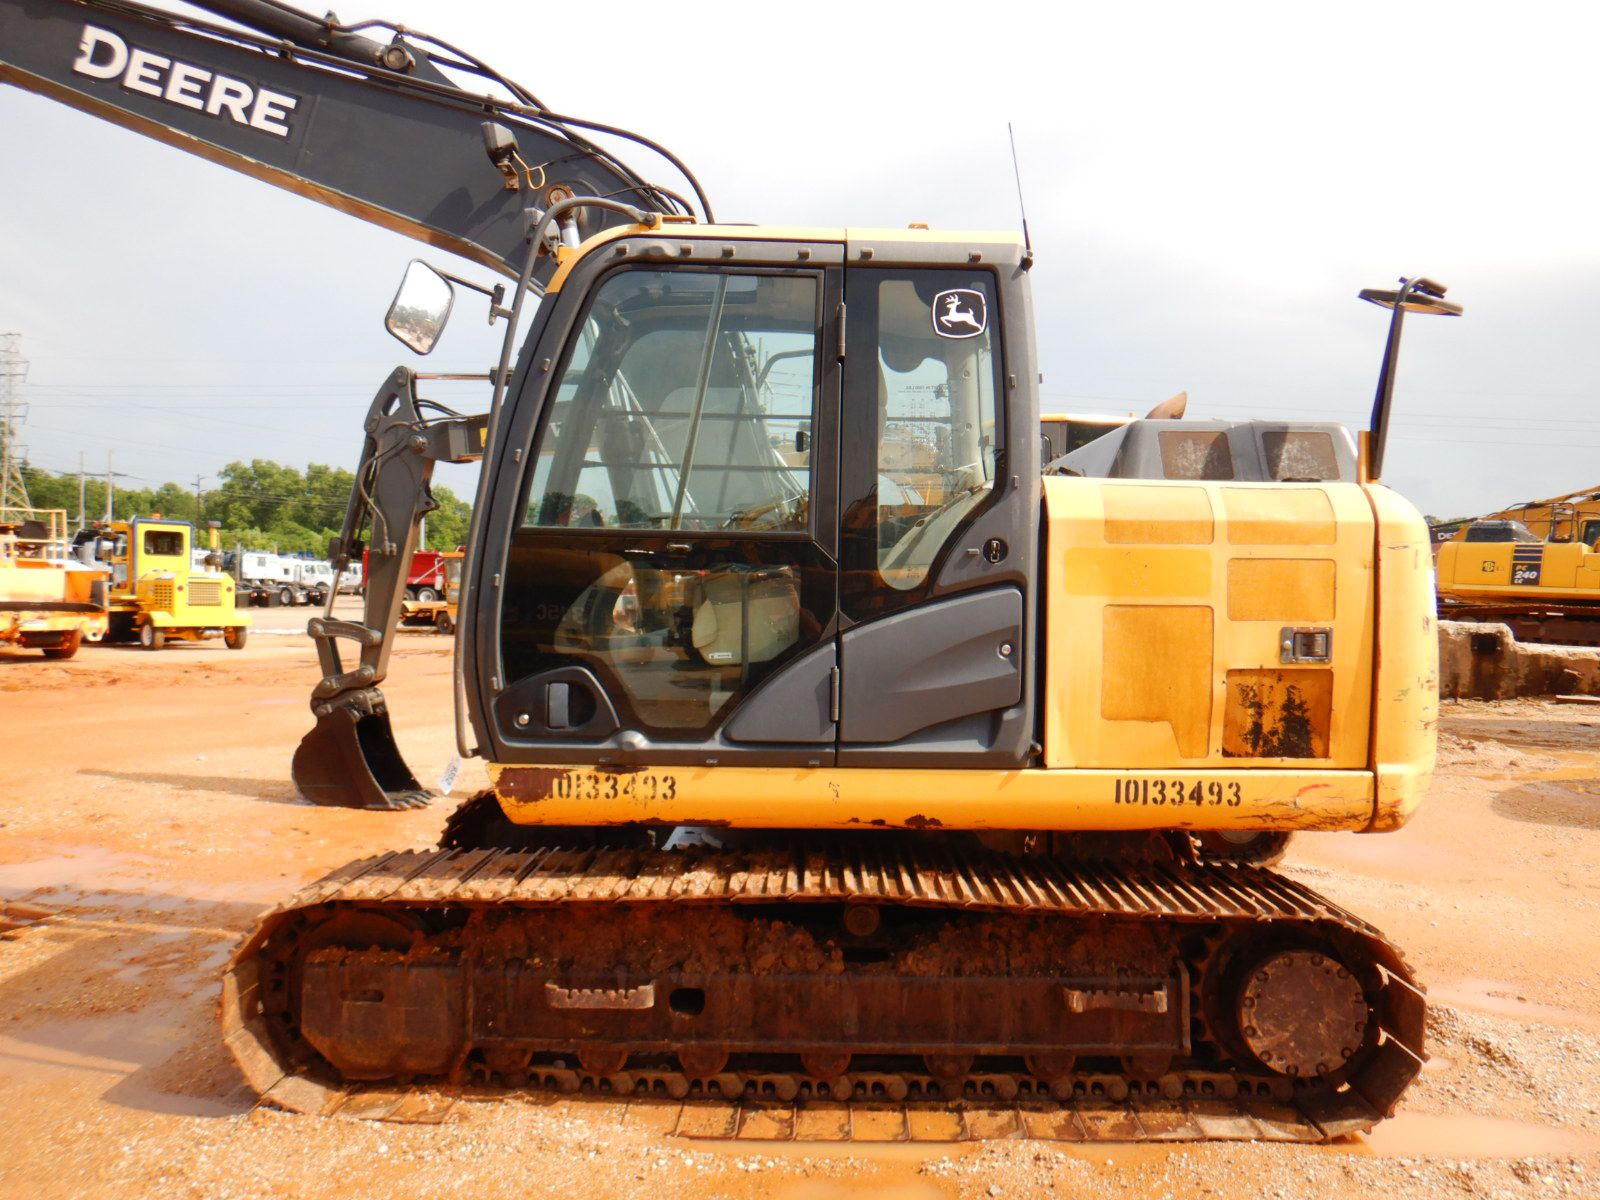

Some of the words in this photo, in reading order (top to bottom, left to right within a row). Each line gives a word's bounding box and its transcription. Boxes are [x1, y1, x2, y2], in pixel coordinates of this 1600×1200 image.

[72, 24, 297, 137] DEERE
[1437, 532, 1457, 541] DE
[1514, 571, 1538, 579] 240
[548, 773, 677, 800] 0133493
[1115, 779, 1242, 807] 10133493
